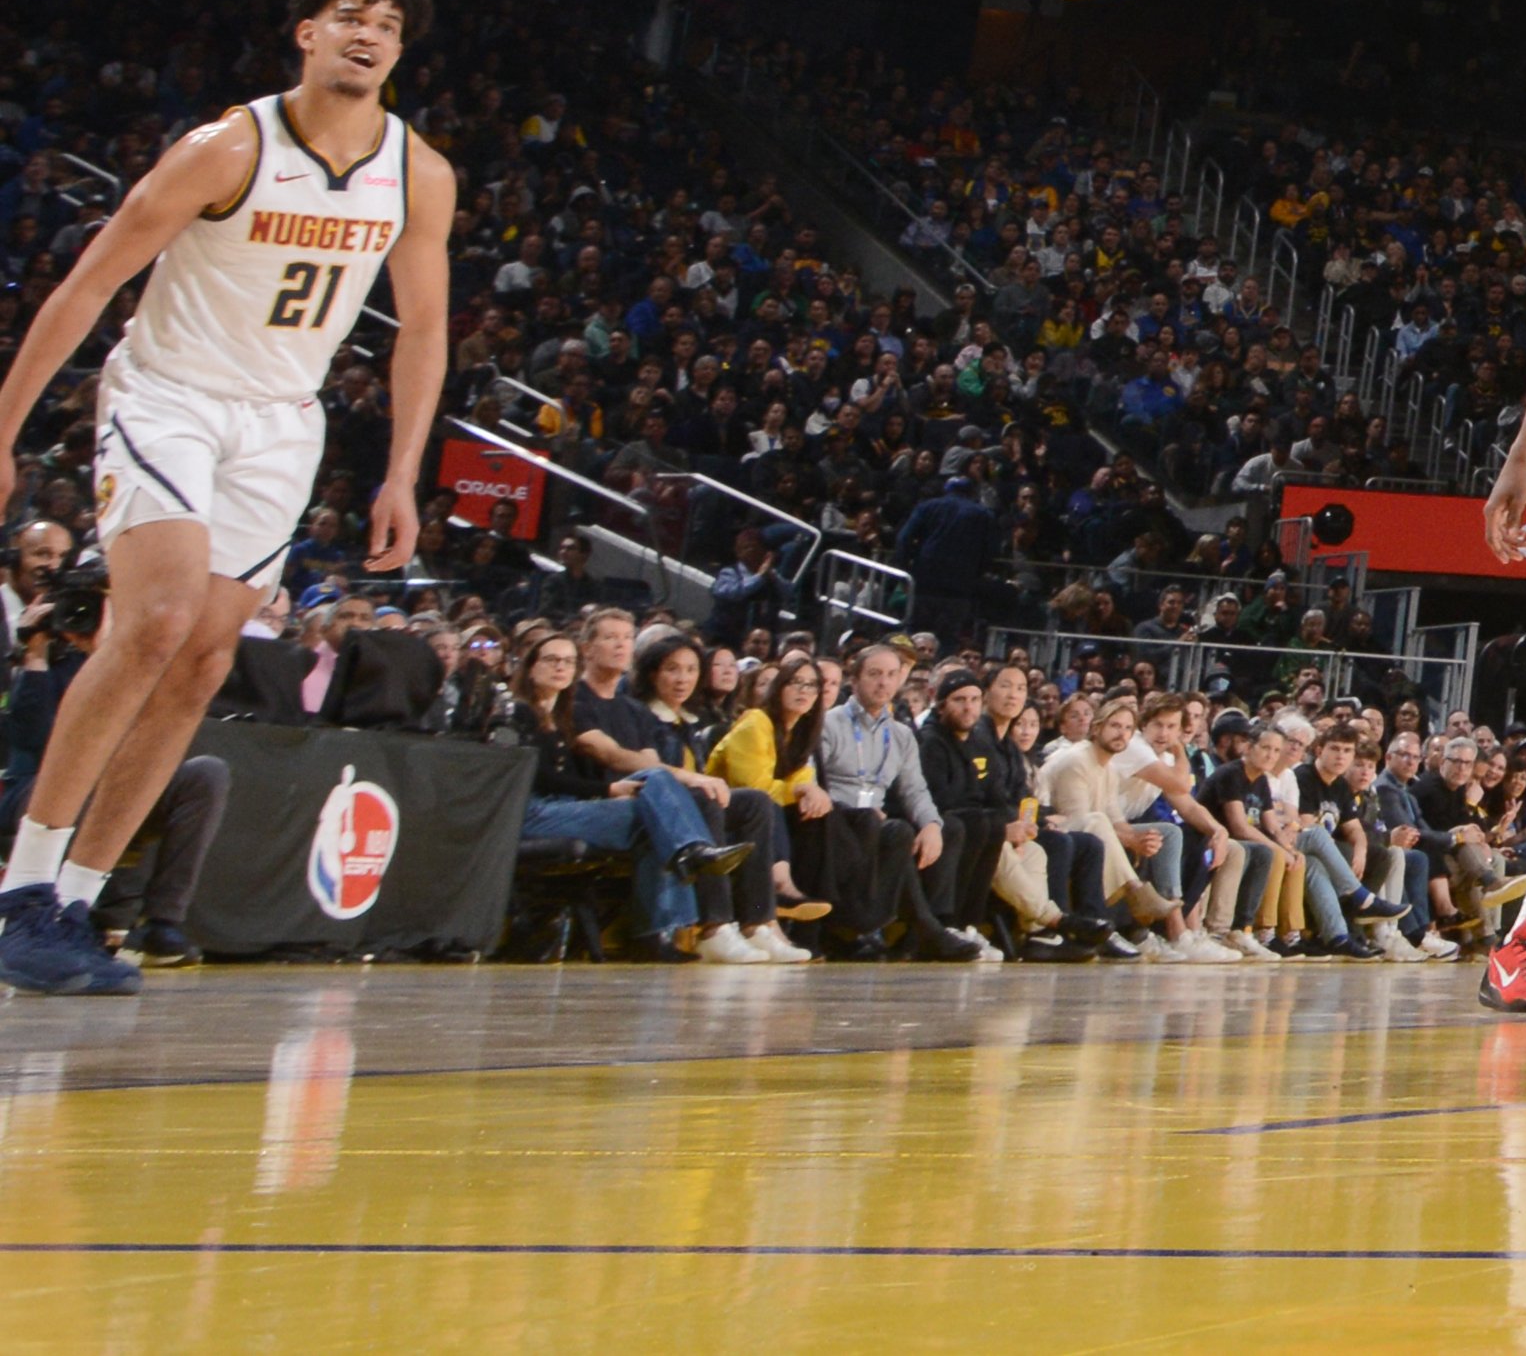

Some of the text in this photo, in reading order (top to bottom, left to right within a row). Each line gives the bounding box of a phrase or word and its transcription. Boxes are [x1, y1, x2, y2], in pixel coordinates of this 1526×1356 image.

[249, 210, 394, 253] NUGGETS
[267, 262, 348, 329] 21
[455, 479, 528, 501] ORACLE
